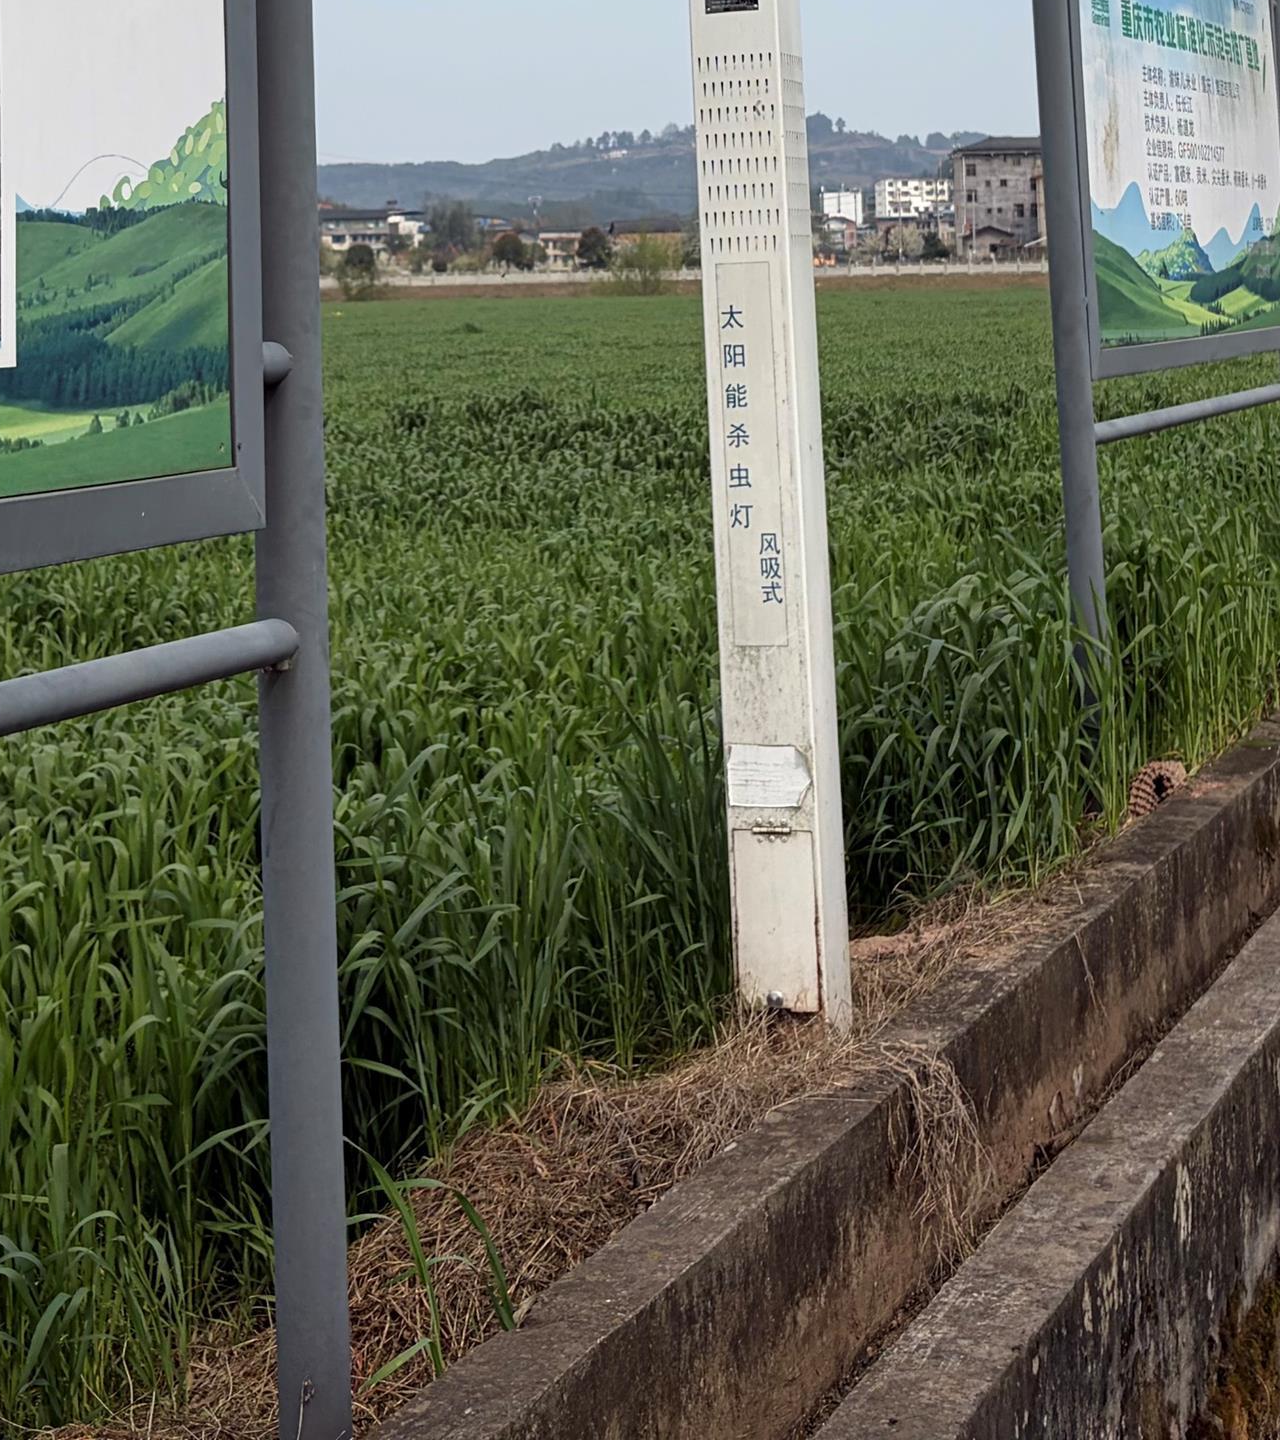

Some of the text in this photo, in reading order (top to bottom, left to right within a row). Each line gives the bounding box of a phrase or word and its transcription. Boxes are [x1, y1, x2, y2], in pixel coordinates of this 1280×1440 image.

[721, 304, 753, 529] 太阳能杀虫灯
[759, 532, 783, 604] 风吸式
